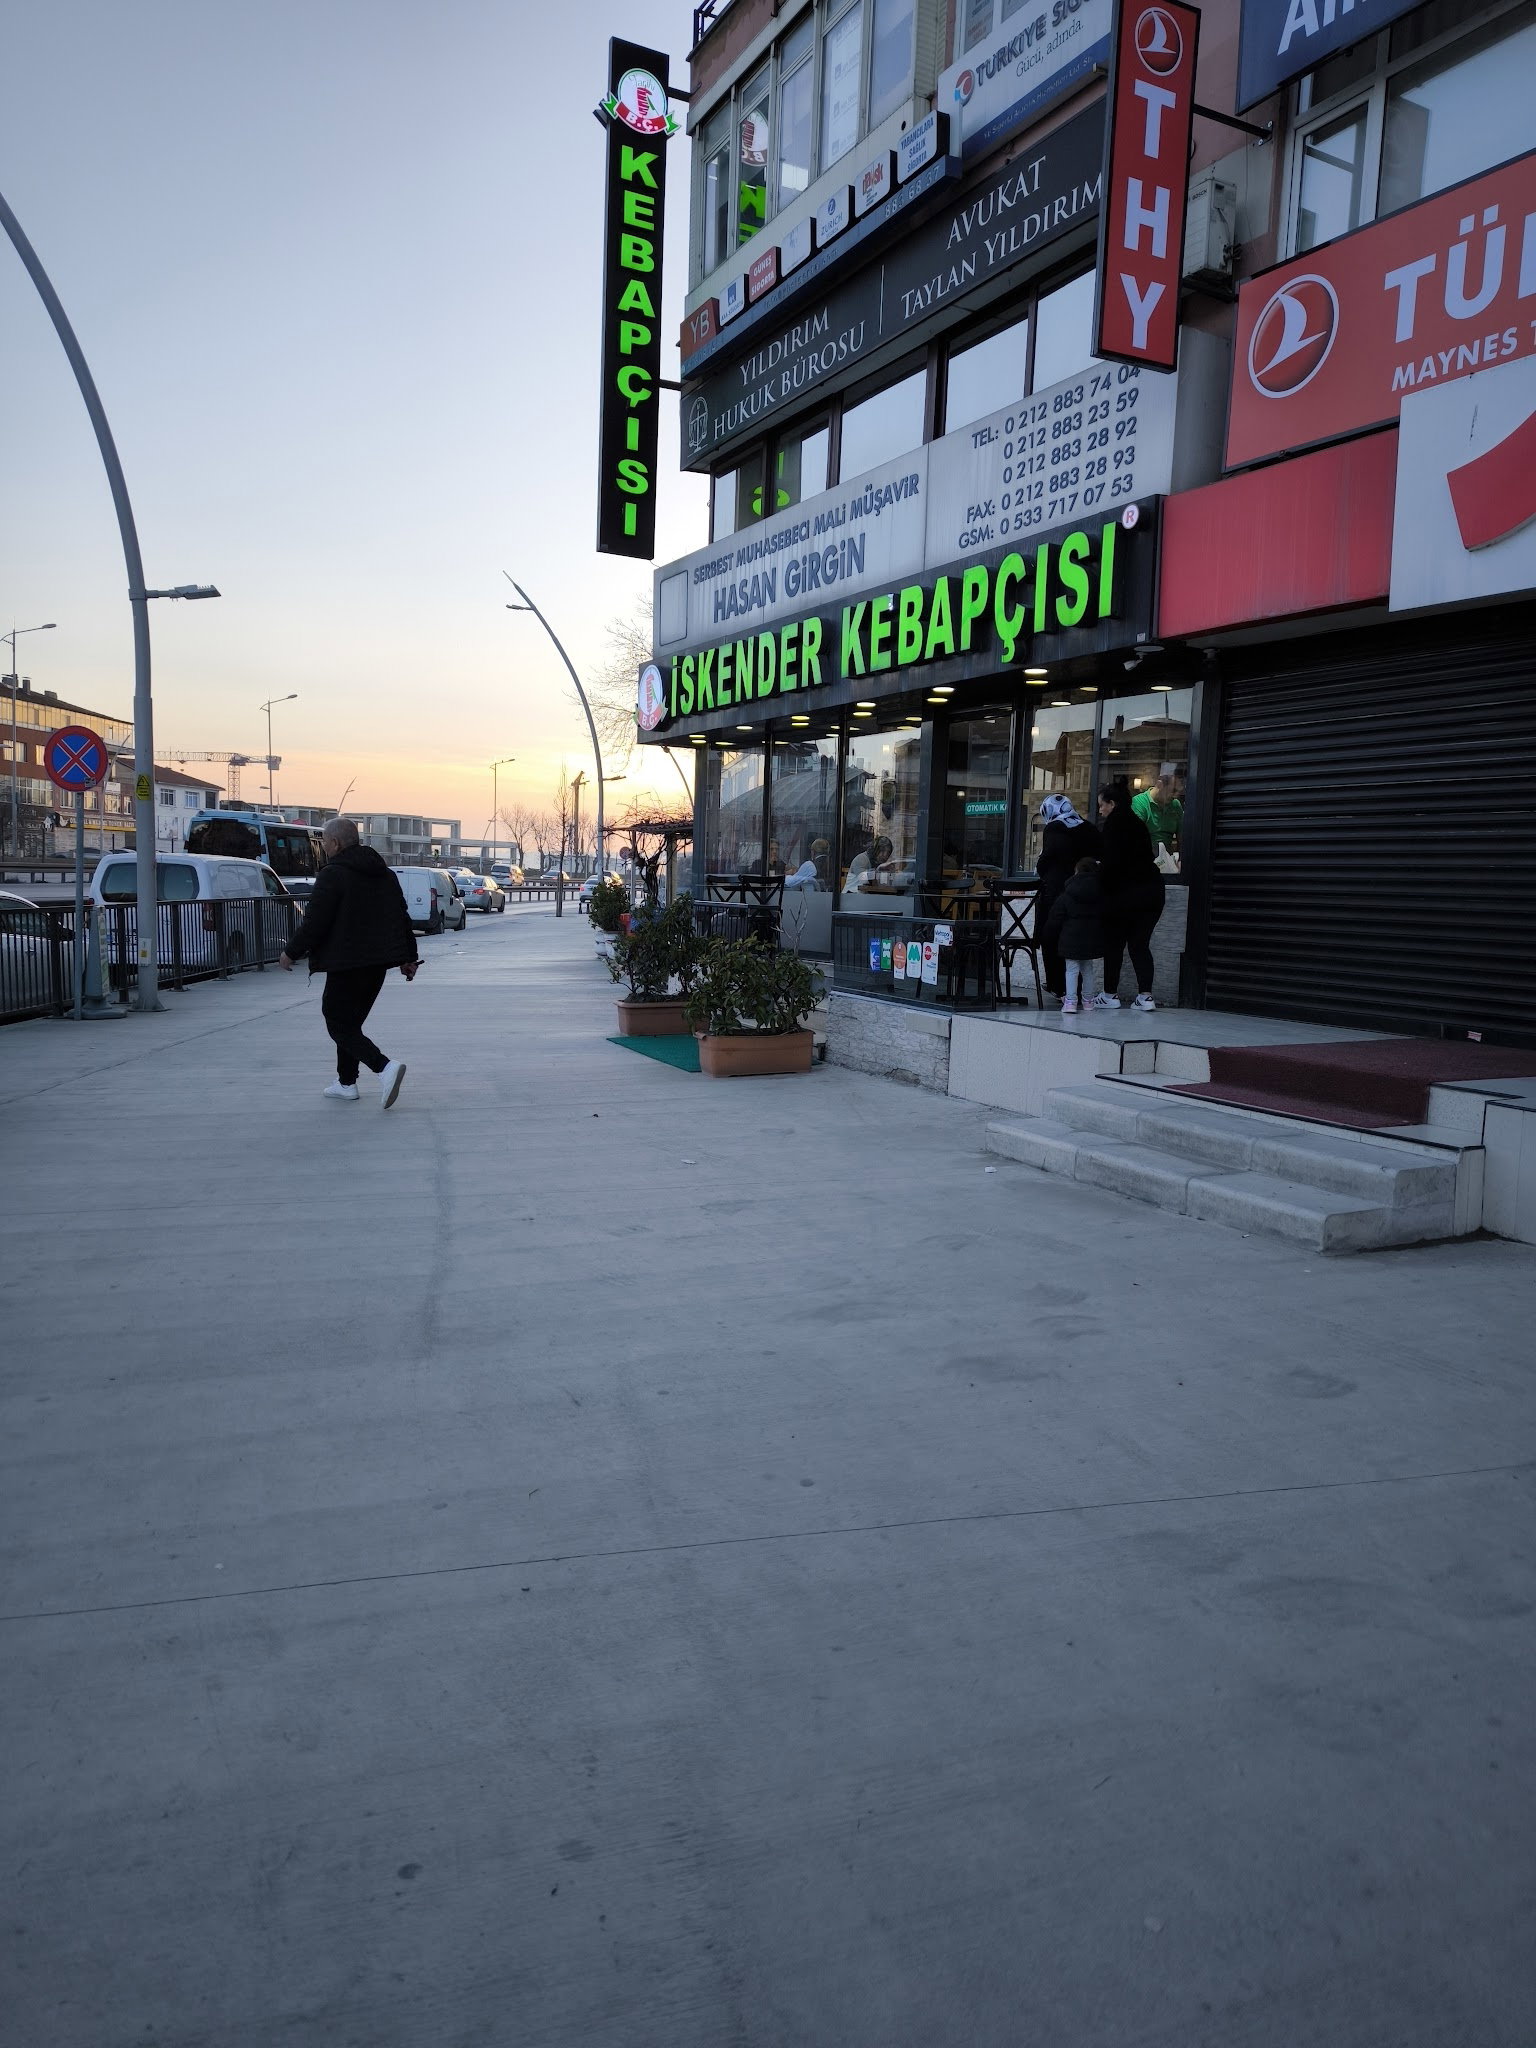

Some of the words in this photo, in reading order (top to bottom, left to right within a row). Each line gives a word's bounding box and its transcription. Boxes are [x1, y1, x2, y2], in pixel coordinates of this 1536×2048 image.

[1016, 46, 1044, 77] Gücü,
[1046, 20, 1084, 55] adında.
[901, 117, 934, 151] YABANCILARA
[908, 179, 922, 200] 68
[926, 165, 940, 186] 37
[946, 155, 1047, 251] AVUKAT
[1119, 78, 1177, 351] THY
[901, 251, 977, 320] TAYLAN
[984, 172, 1102, 266] YILDIRIM
[616, 144, 660, 537] KEBAPÇISI
[690, 308, 710, 345] YB
[740, 307, 830, 386] YILDIRIM
[1391, 327, 1518, 392] MAYNES
[713, 380, 777, 441] HUKUK
[780, 320, 866, 397] BÜROSU
[972, 426, 999, 449] TEL:
[1004, 416, 1015, 435] 0
[1018, 401, 1048, 430] 212
[1053, 385, 1084, 413] 883
[1090, 372, 1111, 398] 74
[1117, 364, 1141, 385] 04
[1002, 467, 1013, 484] 0
[1016, 453, 1046, 480] 212
[1050, 438, 1081, 466] 883
[1087, 427, 1109, 451] 28
[1114, 415, 1138, 441] 92
[1003, 442, 1013, 460] 0
[1017, 427, 1046, 455] 212
[1051, 411, 1082, 440] 883
[1087, 400, 1110, 426] 23
[1115, 387, 1139, 412] 59
[958, 524, 994, 549] GSM:
[1000, 517, 1010, 535] 0
[1013, 505, 1042, 531] 533
[1048, 492, 1078, 519] 717
[1083, 482, 1106, 506] 07
[1110, 473, 1133, 498] 53
[966, 499, 995, 524] FAX:
[1001, 493, 1011, 511] 0
[1014, 480, 1044, 507] 212
[1049, 467, 1080, 493] 883
[1084, 455, 1107, 481] 28
[1113, 445, 1136, 470] 93
[693, 552, 734, 585] SERBEST
[713, 567, 777, 624] HASAN
[670, 616, 824, 718] İSKENDER
[840, 521, 1117, 663] KEBAPÇISI
